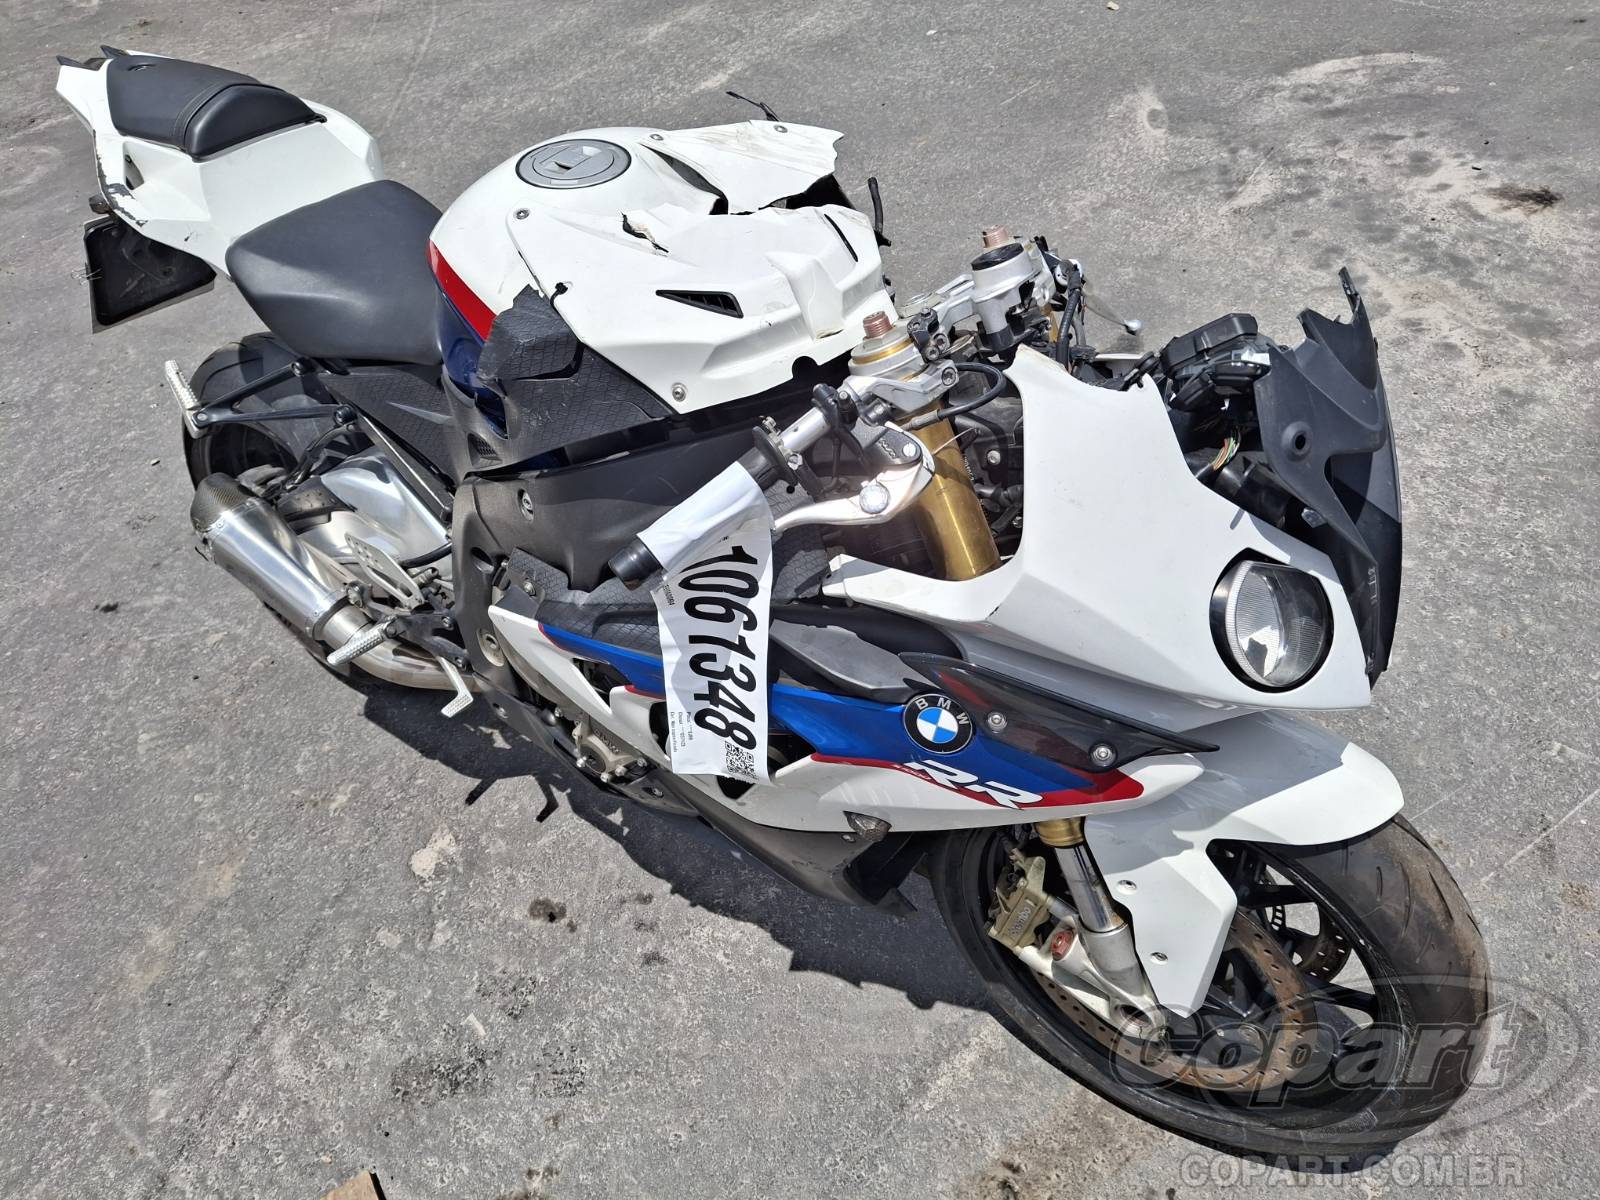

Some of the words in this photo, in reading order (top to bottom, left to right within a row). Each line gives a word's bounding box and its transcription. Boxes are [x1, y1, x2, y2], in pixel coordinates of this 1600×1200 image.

[678, 545, 760, 750] 1061348
[915, 697, 970, 726] BMW
[905, 759, 1043, 811] RR
